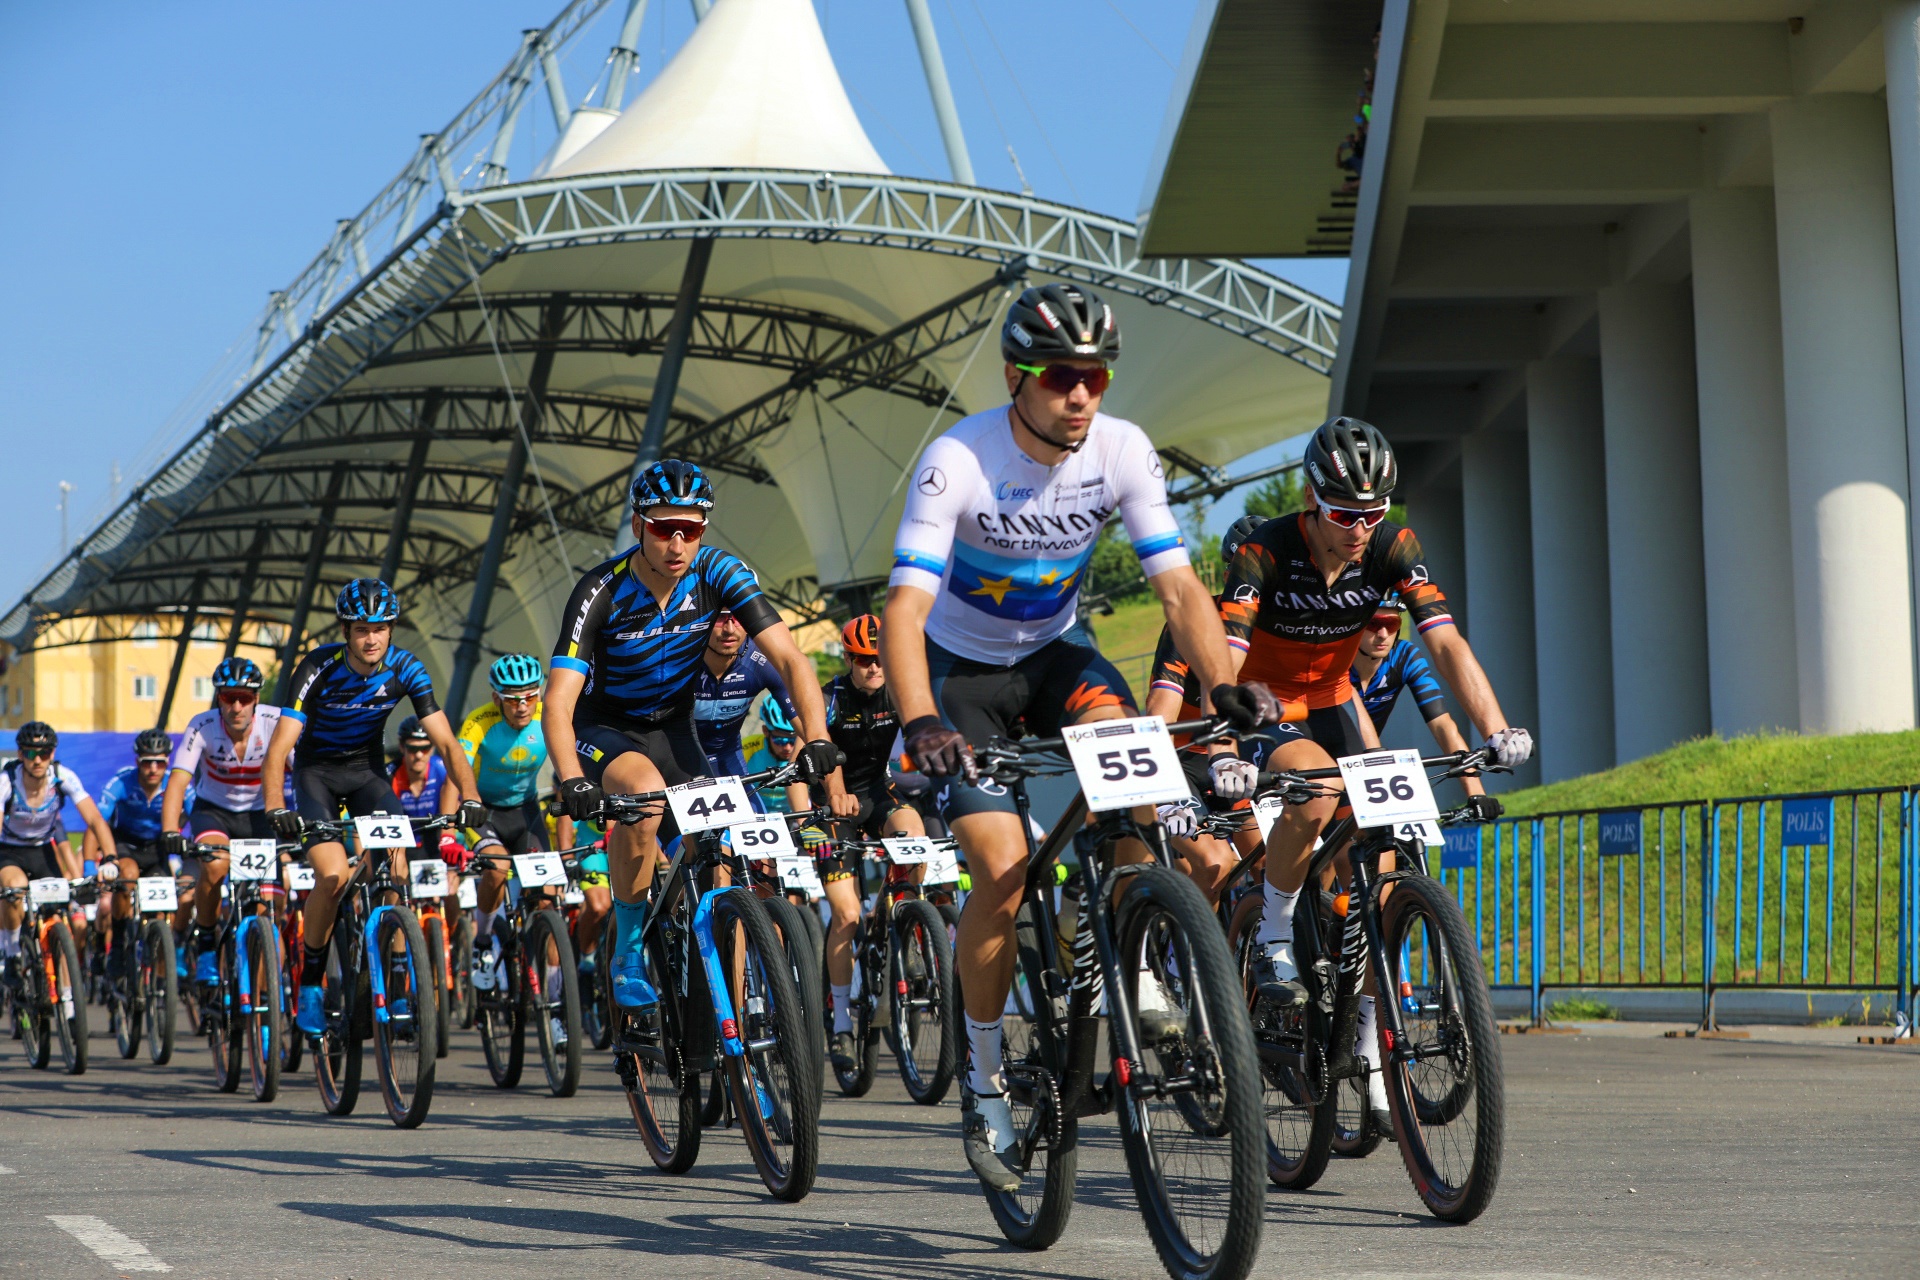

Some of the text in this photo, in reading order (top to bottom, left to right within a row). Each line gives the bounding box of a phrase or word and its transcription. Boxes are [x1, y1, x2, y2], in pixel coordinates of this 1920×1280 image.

[1012, 488, 1034, 497] UEC
[977, 506, 1112, 536] CANYON
[984, 531, 1093, 551] northwave
[571, 570, 614, 643] BULLS
[1275, 585, 1380, 610] CANYON
[615, 621, 711, 640] BULLS
[298, 657, 334, 701] BULLS
[1097, 747, 1158, 781] 55
[671, 785, 687, 794] UCI
[1364, 775, 1414, 803] 56
[687, 793, 737, 817] 44
[370, 826, 402, 839] 43
[741, 829, 779, 846] 50
[1399, 823, 1427, 837] 41
[896, 845, 926, 855] 39
[240, 854, 266, 869] 42
[534, 864, 547, 876] 5
[148, 889, 168, 900] 23
